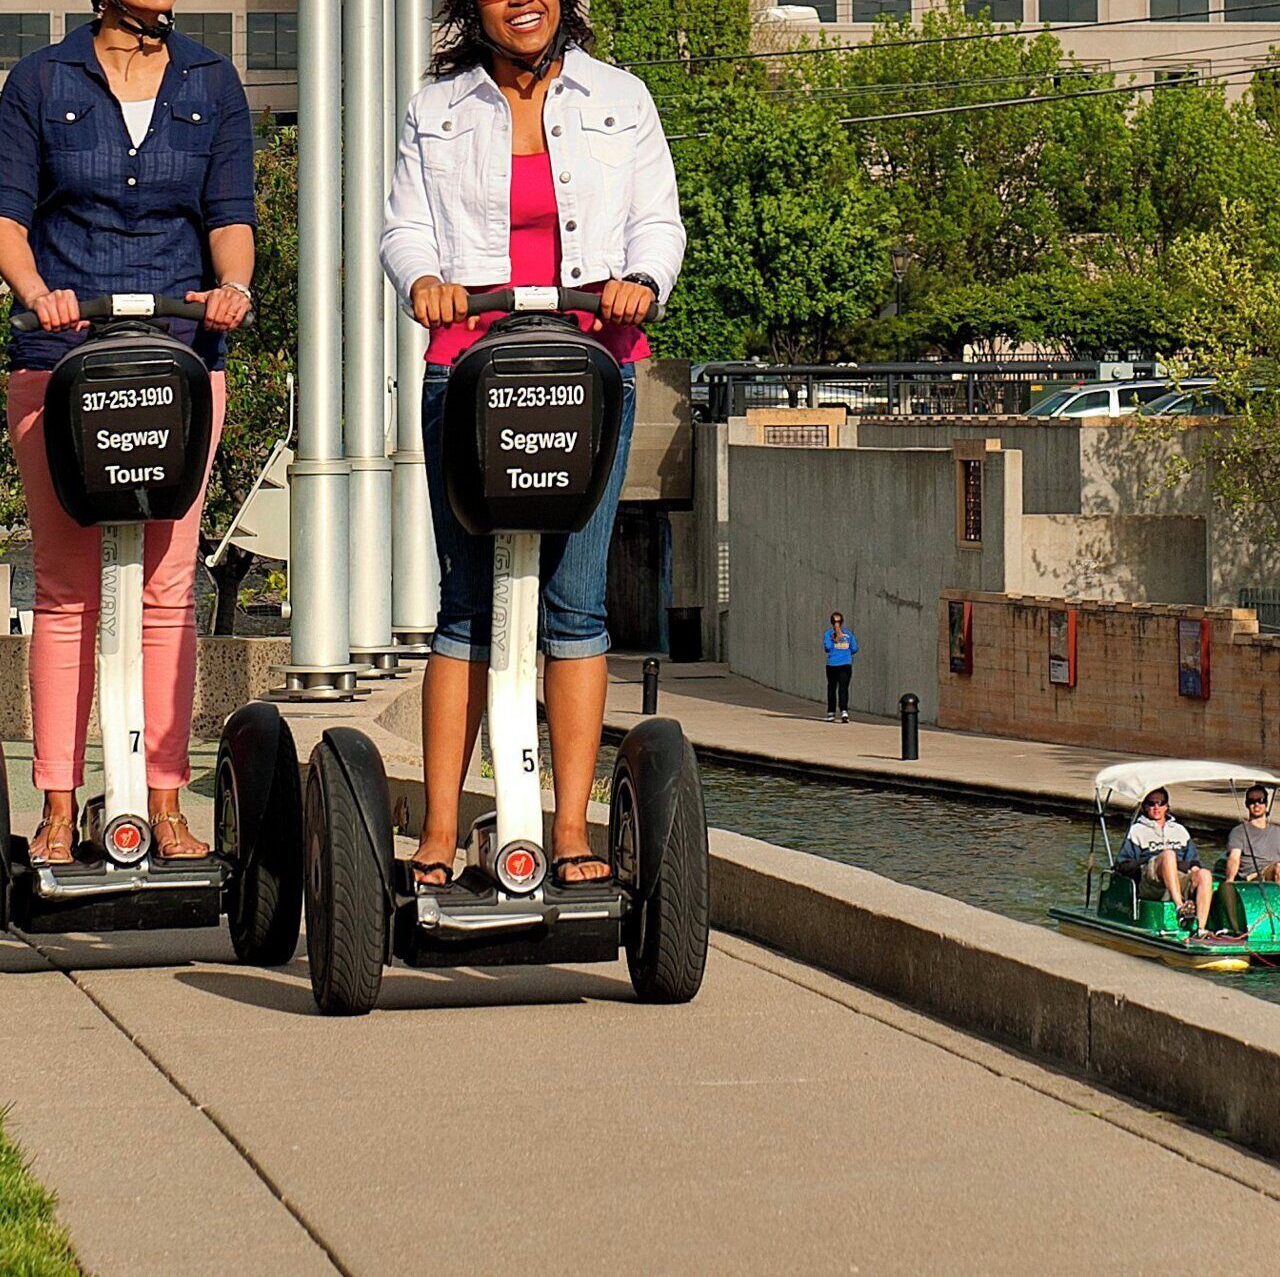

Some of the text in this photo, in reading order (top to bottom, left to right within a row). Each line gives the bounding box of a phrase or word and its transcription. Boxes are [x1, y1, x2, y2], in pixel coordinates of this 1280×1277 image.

[82, 386, 173, 412] 317-253-1910
[488, 385, 585, 408] 317-253-1910
[96, 429, 170, 452] Segway
[500, 429, 578, 454] Segway
[105, 465, 165, 485] Tours
[506, 468, 569, 489] Tours
[129, 730, 141, 753] 7
[522, 748, 535, 773] 5
